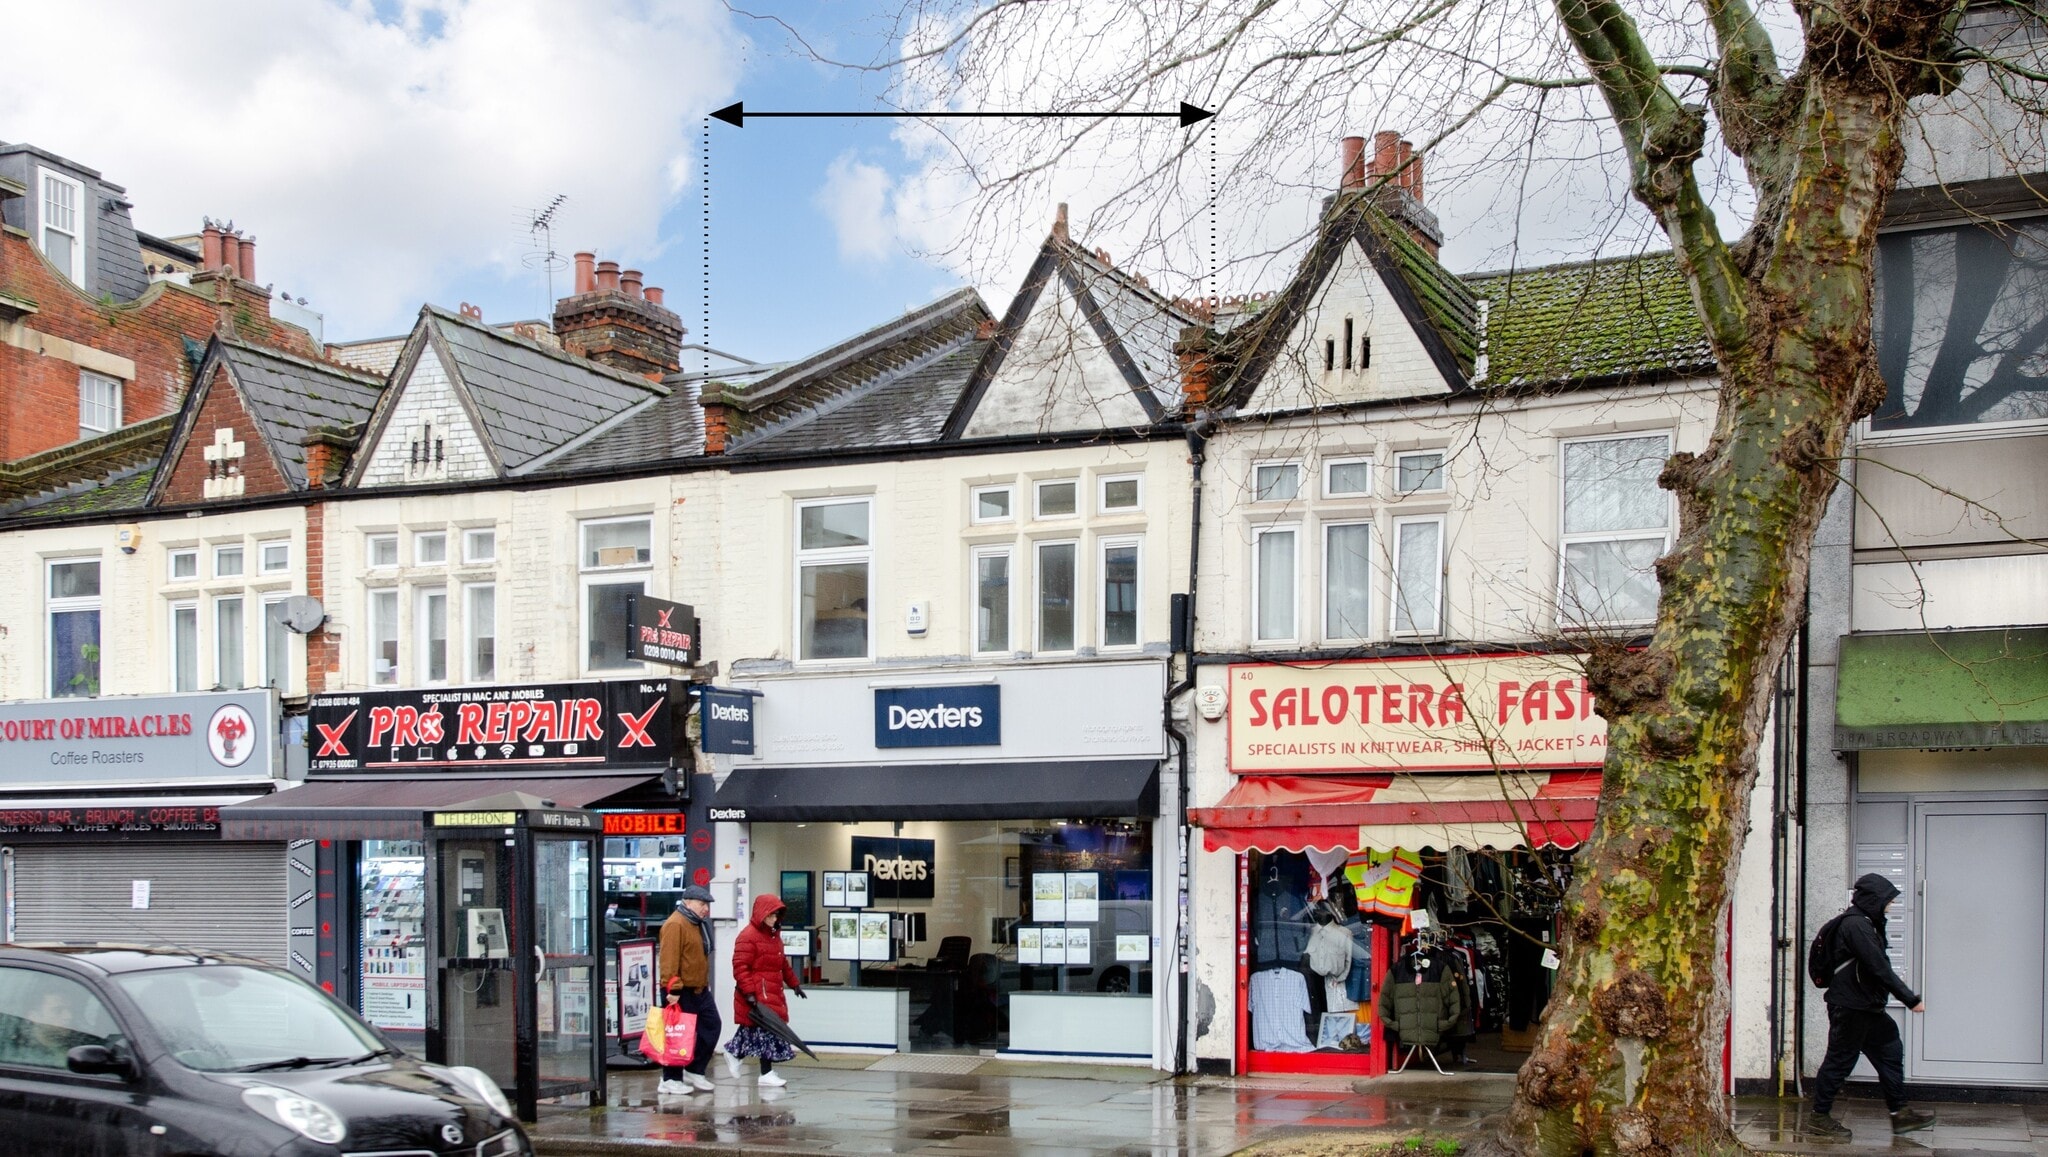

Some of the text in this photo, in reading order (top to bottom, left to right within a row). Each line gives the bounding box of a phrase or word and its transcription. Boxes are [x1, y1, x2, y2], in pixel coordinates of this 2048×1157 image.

[660, 630, 691, 650] REPAIR
[644, 644, 687, 662] 0208 0010 484
[1240, 672, 1253, 681] 40
[422, 692, 461, 703] SPECIALIST
[462, 692, 471, 702] IN
[472, 691, 492, 701] MAC
[511, 689, 544, 700] MOBILES
[640, 683, 667, 693] No. 44
[712, 703, 749, 722] Dexters
[1249, 683, 1465, 731] SALOTERA
[456, 698, 604, 745] REPAIR
[888, 703, 983, 730] Dexters
[60, 717, 84, 740] OF
[88, 713, 192, 739] MIRACLES
[1876, 730, 1964, 742] BROADWAY
[1991, 728, 2041, 739] FLATS
[1248, 742, 1336, 756] SPECIALISTS
[1341, 742, 1355, 754] IN
[1360, 740, 1448, 755] KNITWEAR,
[1517, 735, 1585, 752] JACKETS
[50, 750, 144, 766] Coffee Roasters
[48, 810, 72, 824] BAR
[85, 809, 135, 823] BRUNCH
[150, 808, 197, 823] COFFEE
[203, 808, 219, 822] BE
[441, 811, 509, 825] TELEPHONE
[542, 813, 581, 827] WiFi here
[709, 808, 746, 820] Dexters
[163, 821, 217, 831] SMOOTHIES
[605, 815, 676, 833] MOBILE
[290, 858, 312, 877] COFFEE
[864, 854, 927, 880] Dexters
[291, 890, 313, 909] COFFEE
[291, 928, 315, 936] COFFEE
[291, 951, 312, 972] COFFEE
